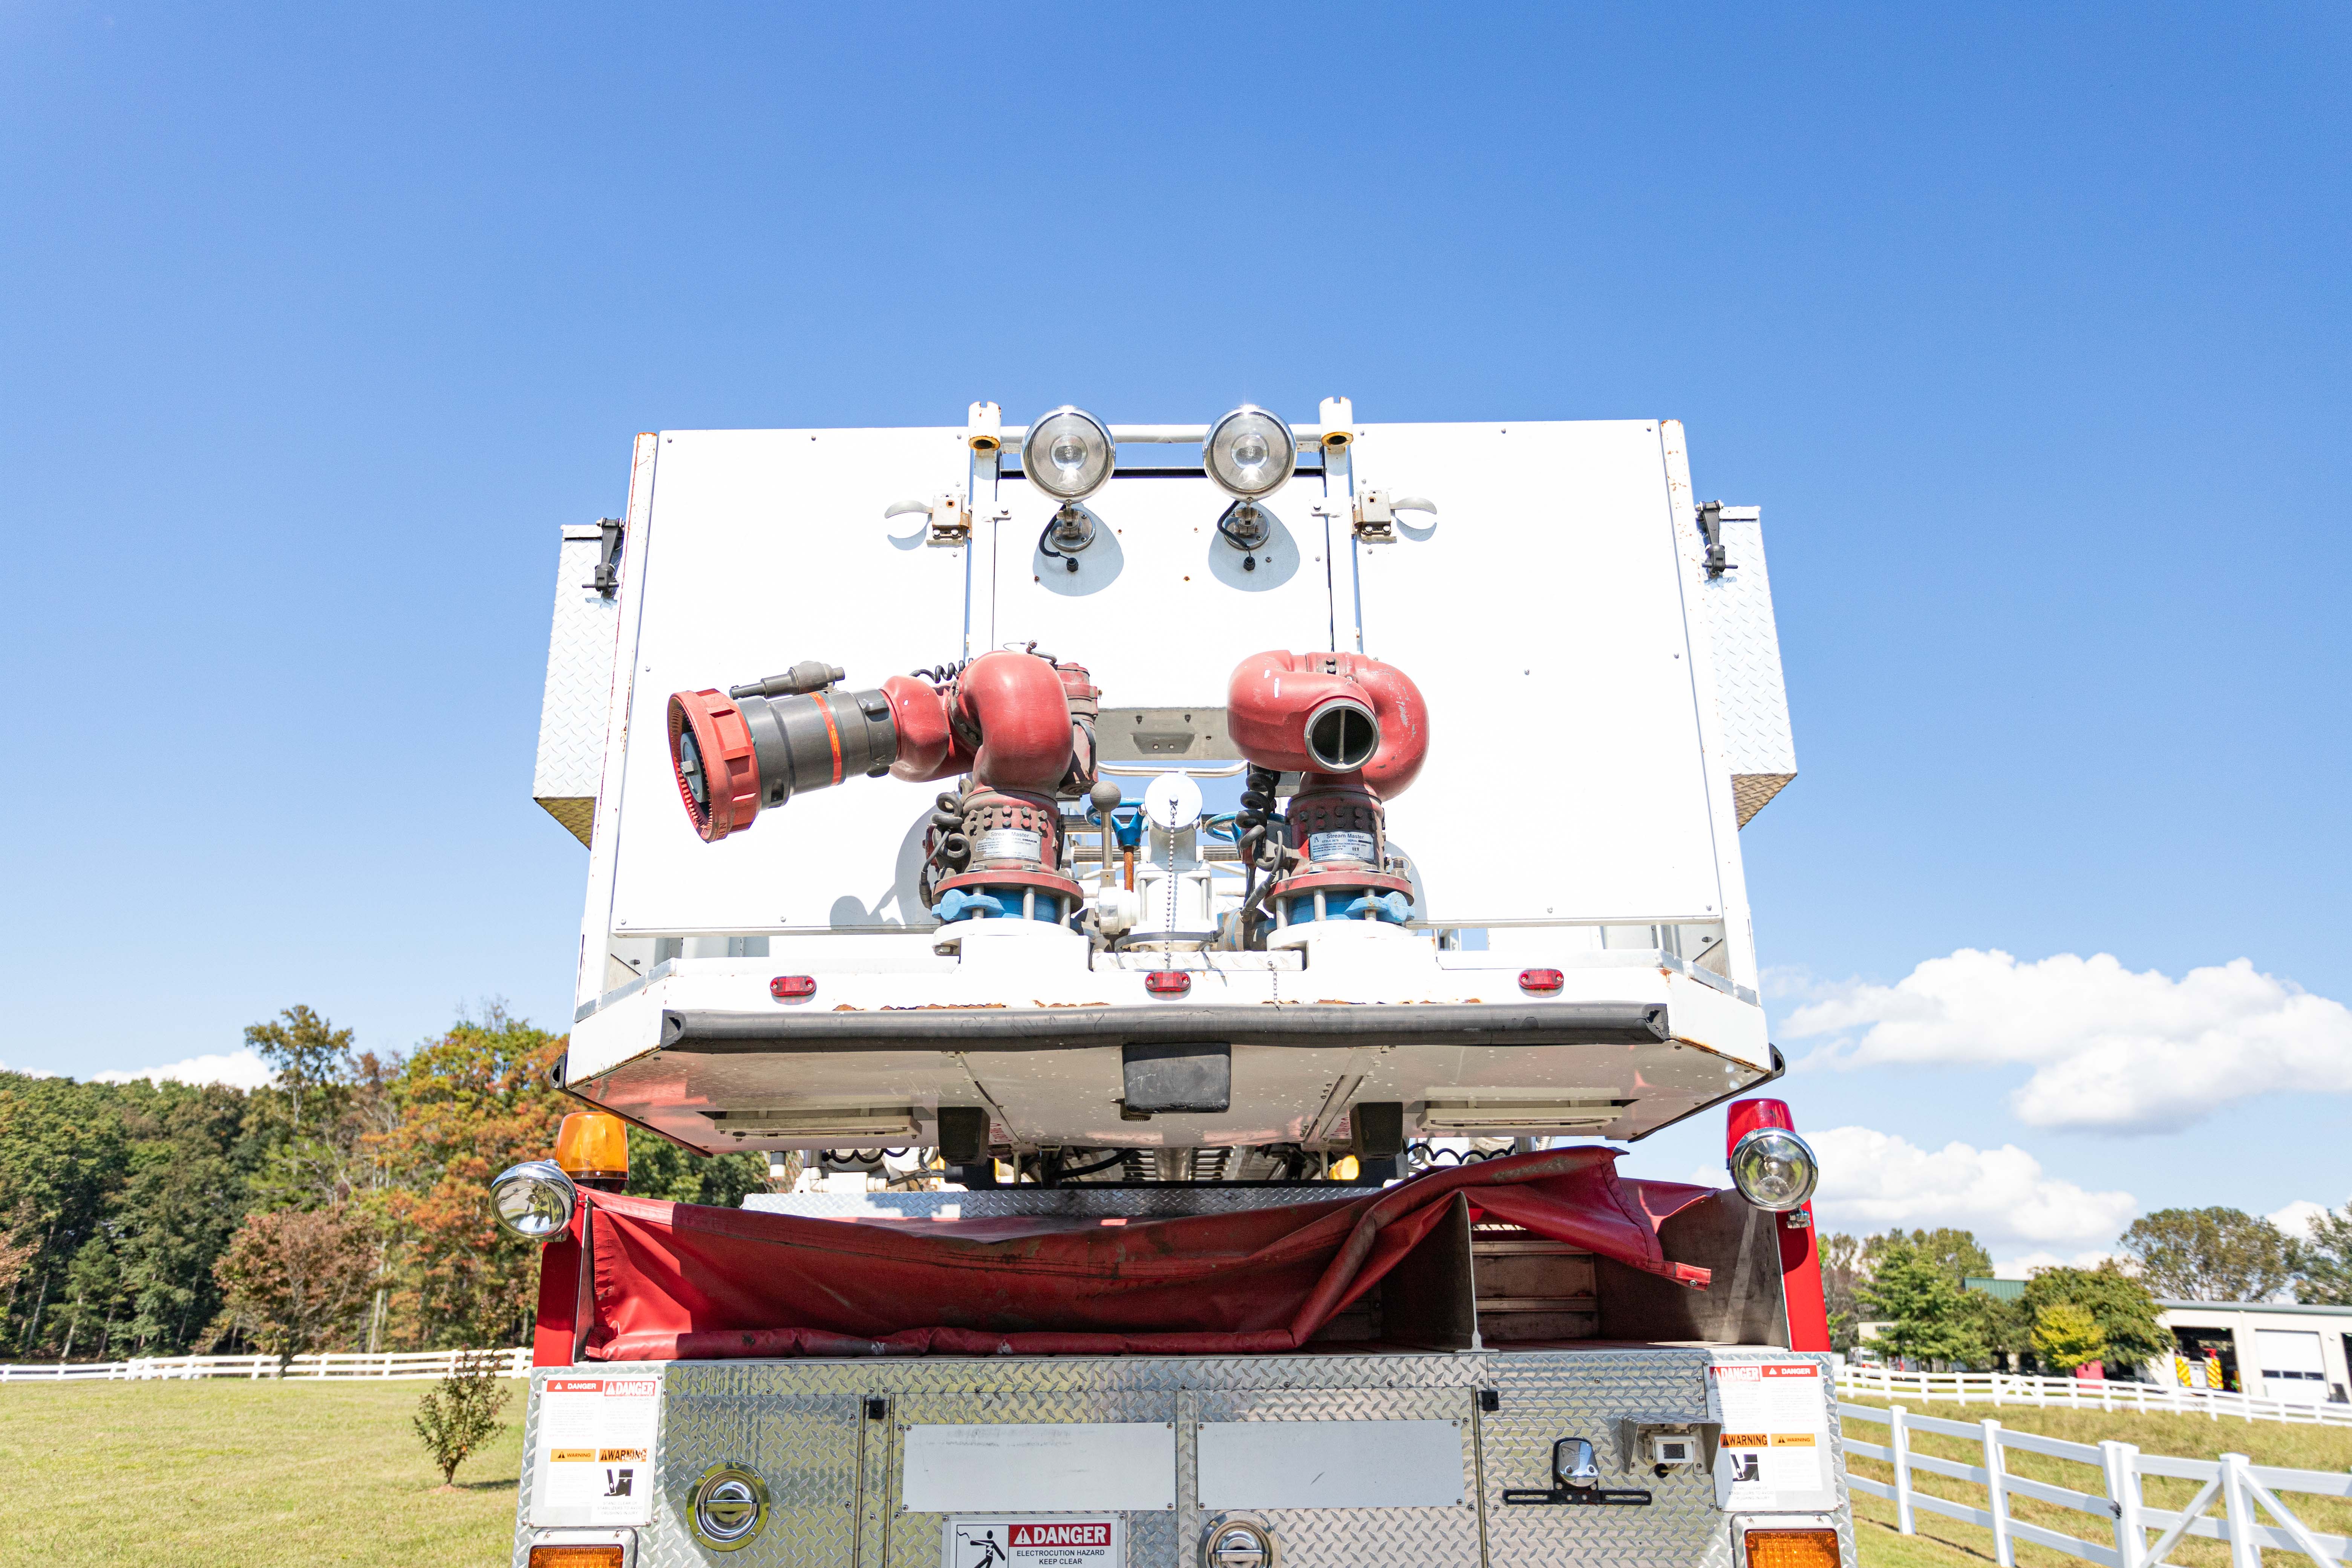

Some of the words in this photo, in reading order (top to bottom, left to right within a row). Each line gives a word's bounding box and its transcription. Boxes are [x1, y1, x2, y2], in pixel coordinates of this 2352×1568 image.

[1720, 1367, 1759, 1380] DANGER
[615, 1382, 654, 1395] DANGER
[1729, 1435, 1767, 1446] WARNING
[608, 1450, 646, 1461] WARNING
[1034, 1526, 1106, 1544] DANGER
